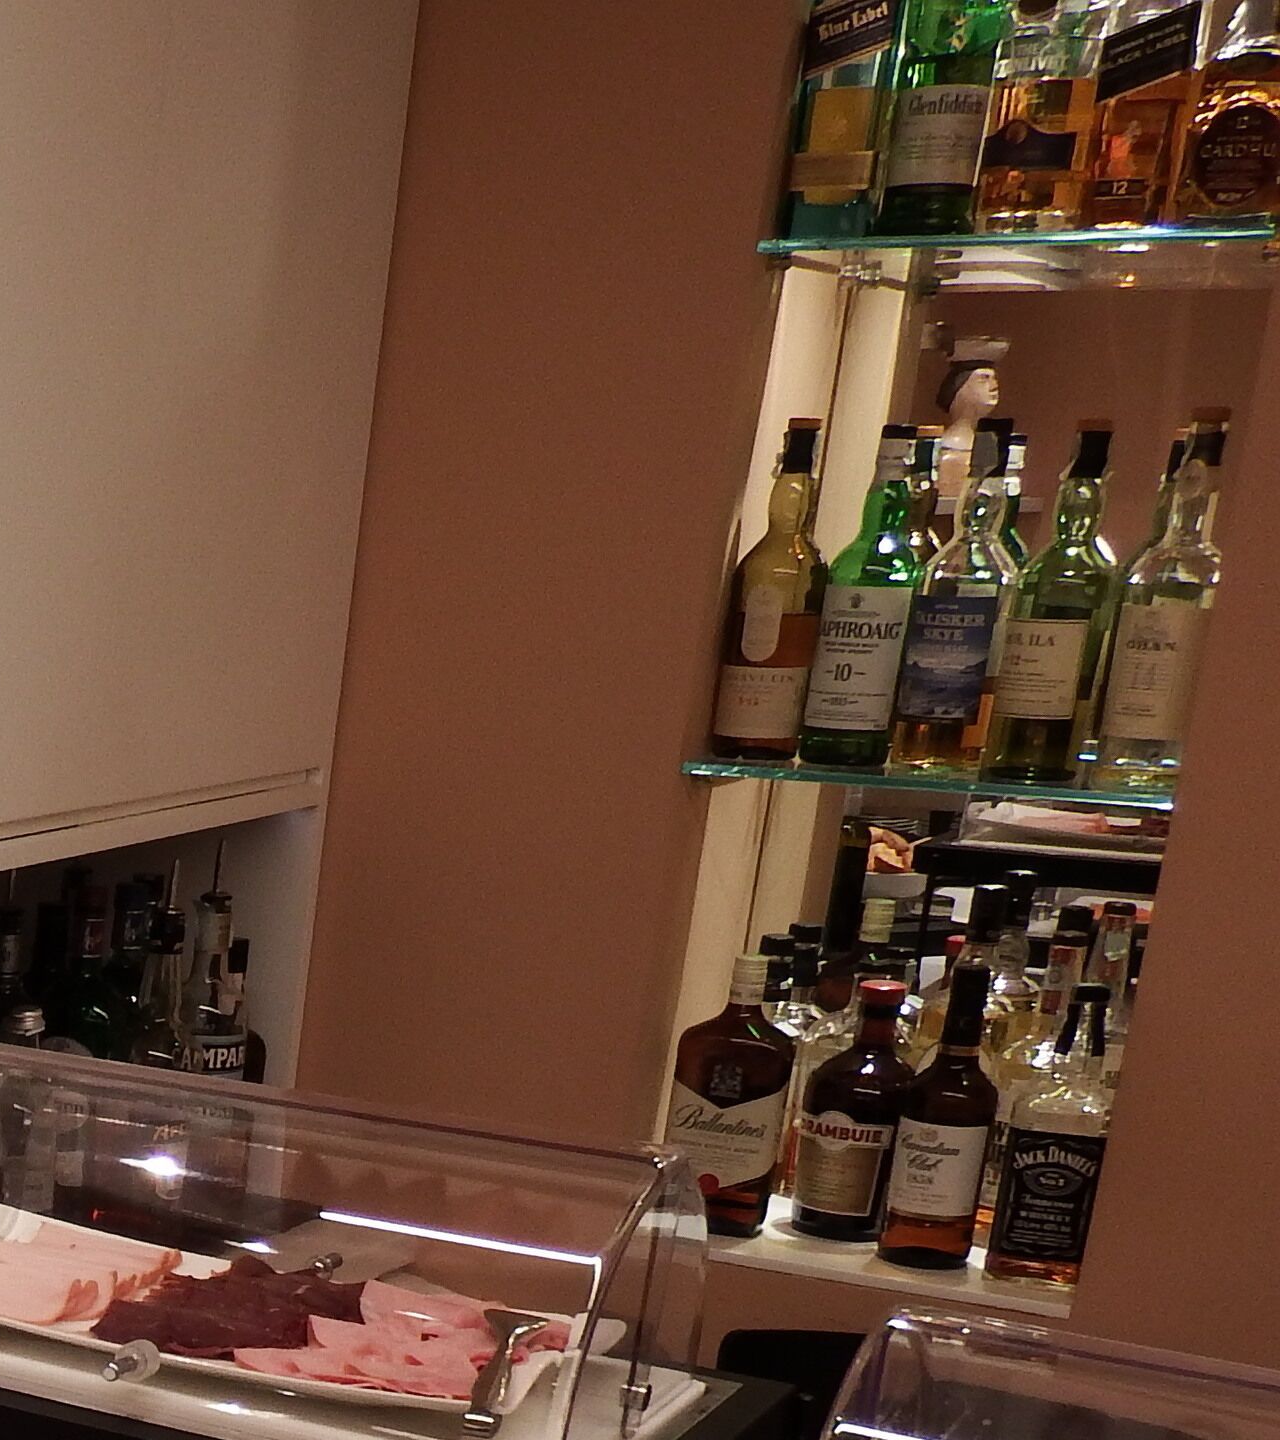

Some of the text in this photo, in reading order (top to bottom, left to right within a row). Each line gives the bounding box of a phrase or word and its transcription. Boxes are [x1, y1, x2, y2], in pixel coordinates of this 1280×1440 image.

[851, 2, 889, 29] Label
[1111, 181, 1129, 195] 12
[833, 662, 853, 683] 10
[674, 1103, 769, 1139] Ballantine's
[1012, 1149, 1046, 1170] JACK
